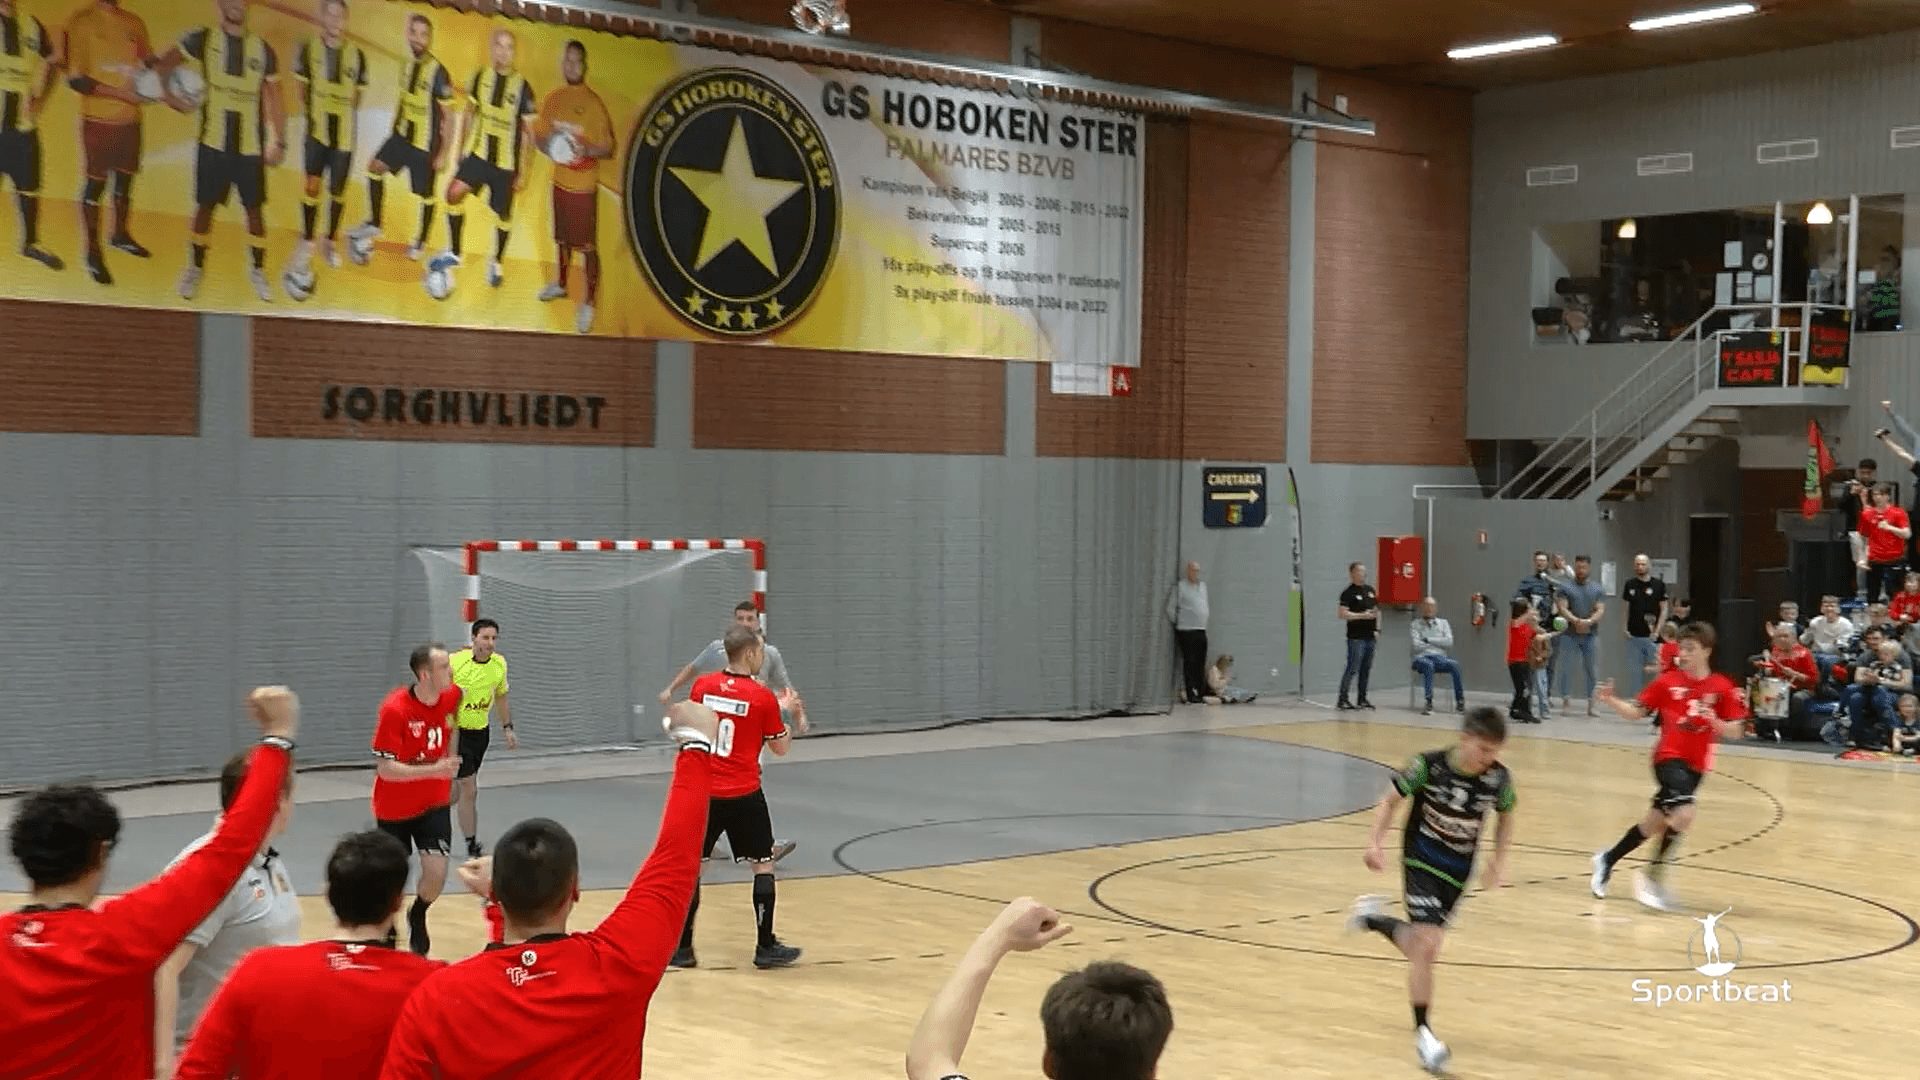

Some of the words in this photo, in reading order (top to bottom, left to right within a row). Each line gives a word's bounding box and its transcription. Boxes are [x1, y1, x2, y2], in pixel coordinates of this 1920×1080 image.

[822, 80, 871, 120] GS
[883, 89, 1049, 145] HOBOKEN
[1059, 115, 1137, 157] STER
[645, 111, 675, 147] GS
[671, 80, 792, 122] HOBOKEN
[791, 116, 833, 188] STER
[886, 135, 1010, 173] PALMARES
[1017, 152, 1076, 180] BZVB
[861, 176, 923, 197] Kampioen
[907, 205, 989, 227] Bekerwinnaar
[929, 233, 988, 254] Supercup
[1114, 372, 1129, 391] A
[321, 385, 607, 430] SORGHVLIEDT
[427, 724, 443, 751] 21
